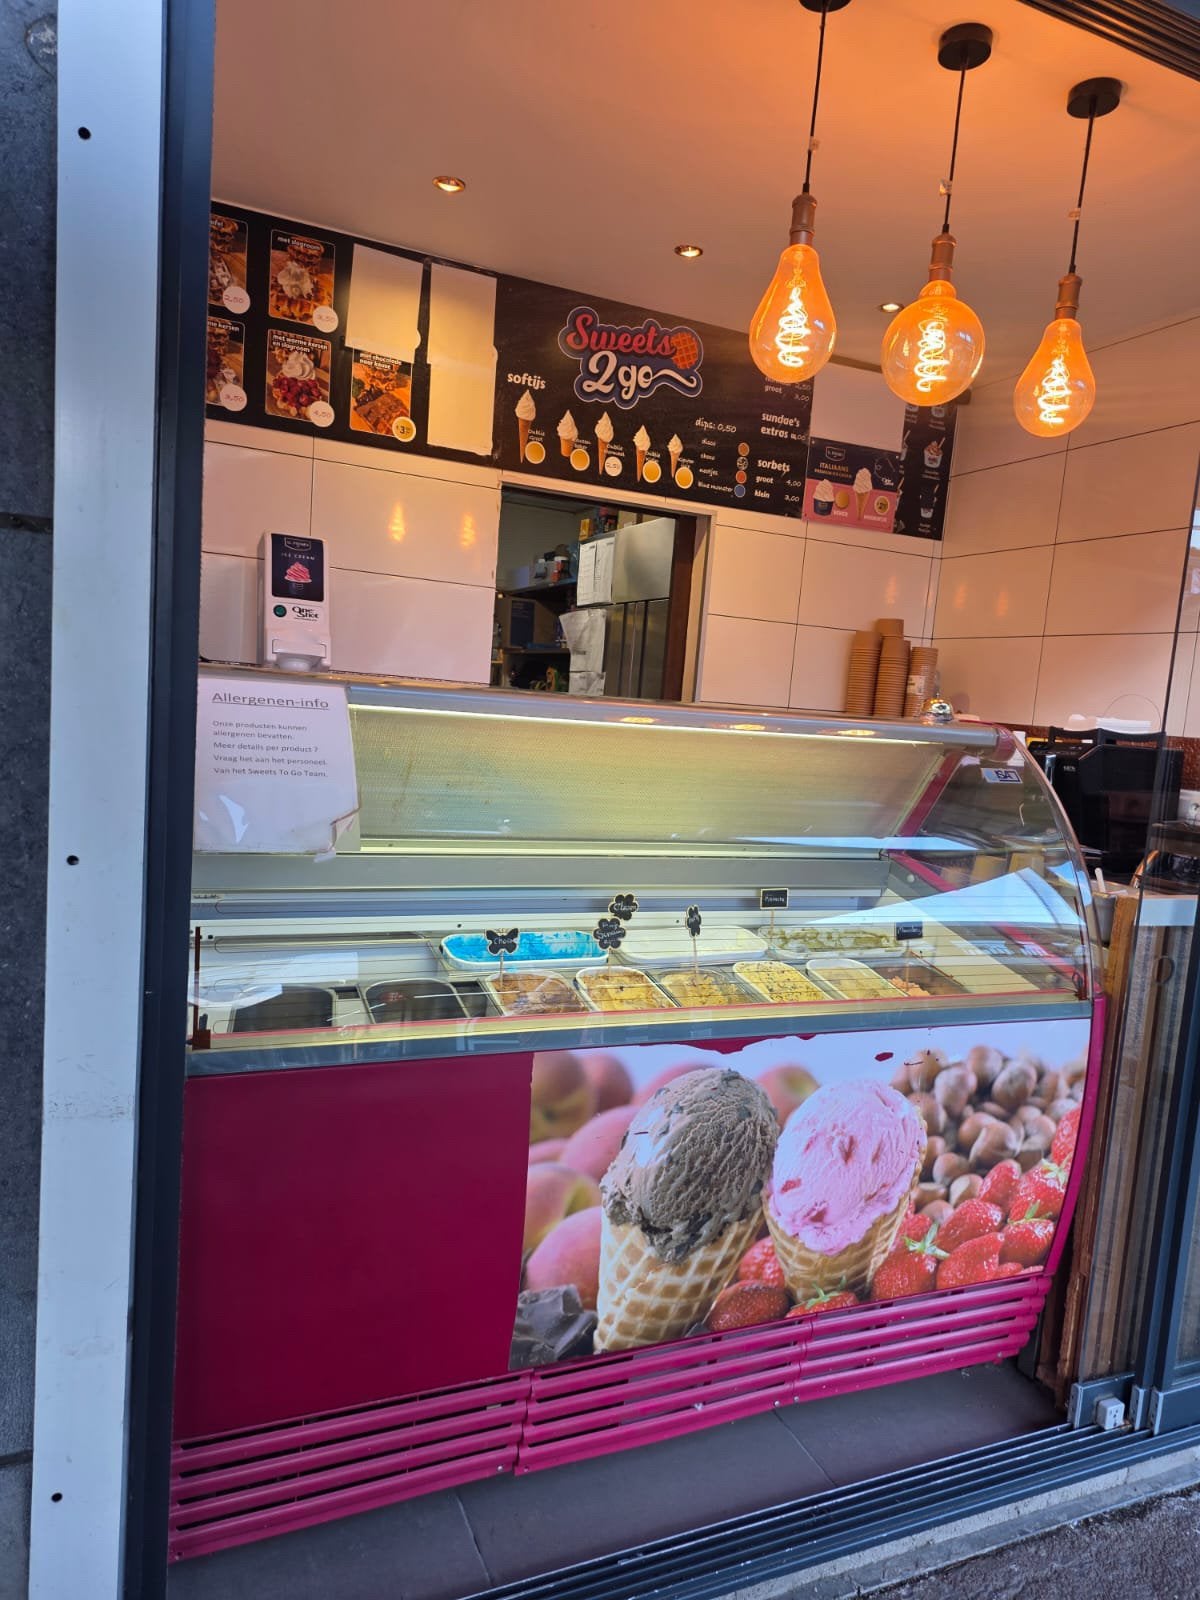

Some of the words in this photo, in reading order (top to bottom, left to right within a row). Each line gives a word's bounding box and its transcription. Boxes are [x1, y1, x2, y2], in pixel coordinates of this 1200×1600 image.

[566, 313, 677, 357] Sweets
[507, 372, 546, 390] softijs
[764, 385, 783, 394] groot
[761, 413, 800, 428] sundae's
[760, 426, 788, 439] extras
[757, 459, 791, 472] sorbets
[755, 475, 774, 484] groot
[754, 490, 770, 499] klein
[212, 692, 330, 709] Allergenen-info
[235, 722, 277, 730] producten
[213, 730, 256, 738] allergenen
[237, 743, 264, 751] details
[265, 745, 279, 753] per
[281, 744, 312, 754] product
[213, 754, 238, 763] Vraag
[248, 768, 277, 776] Sweets
